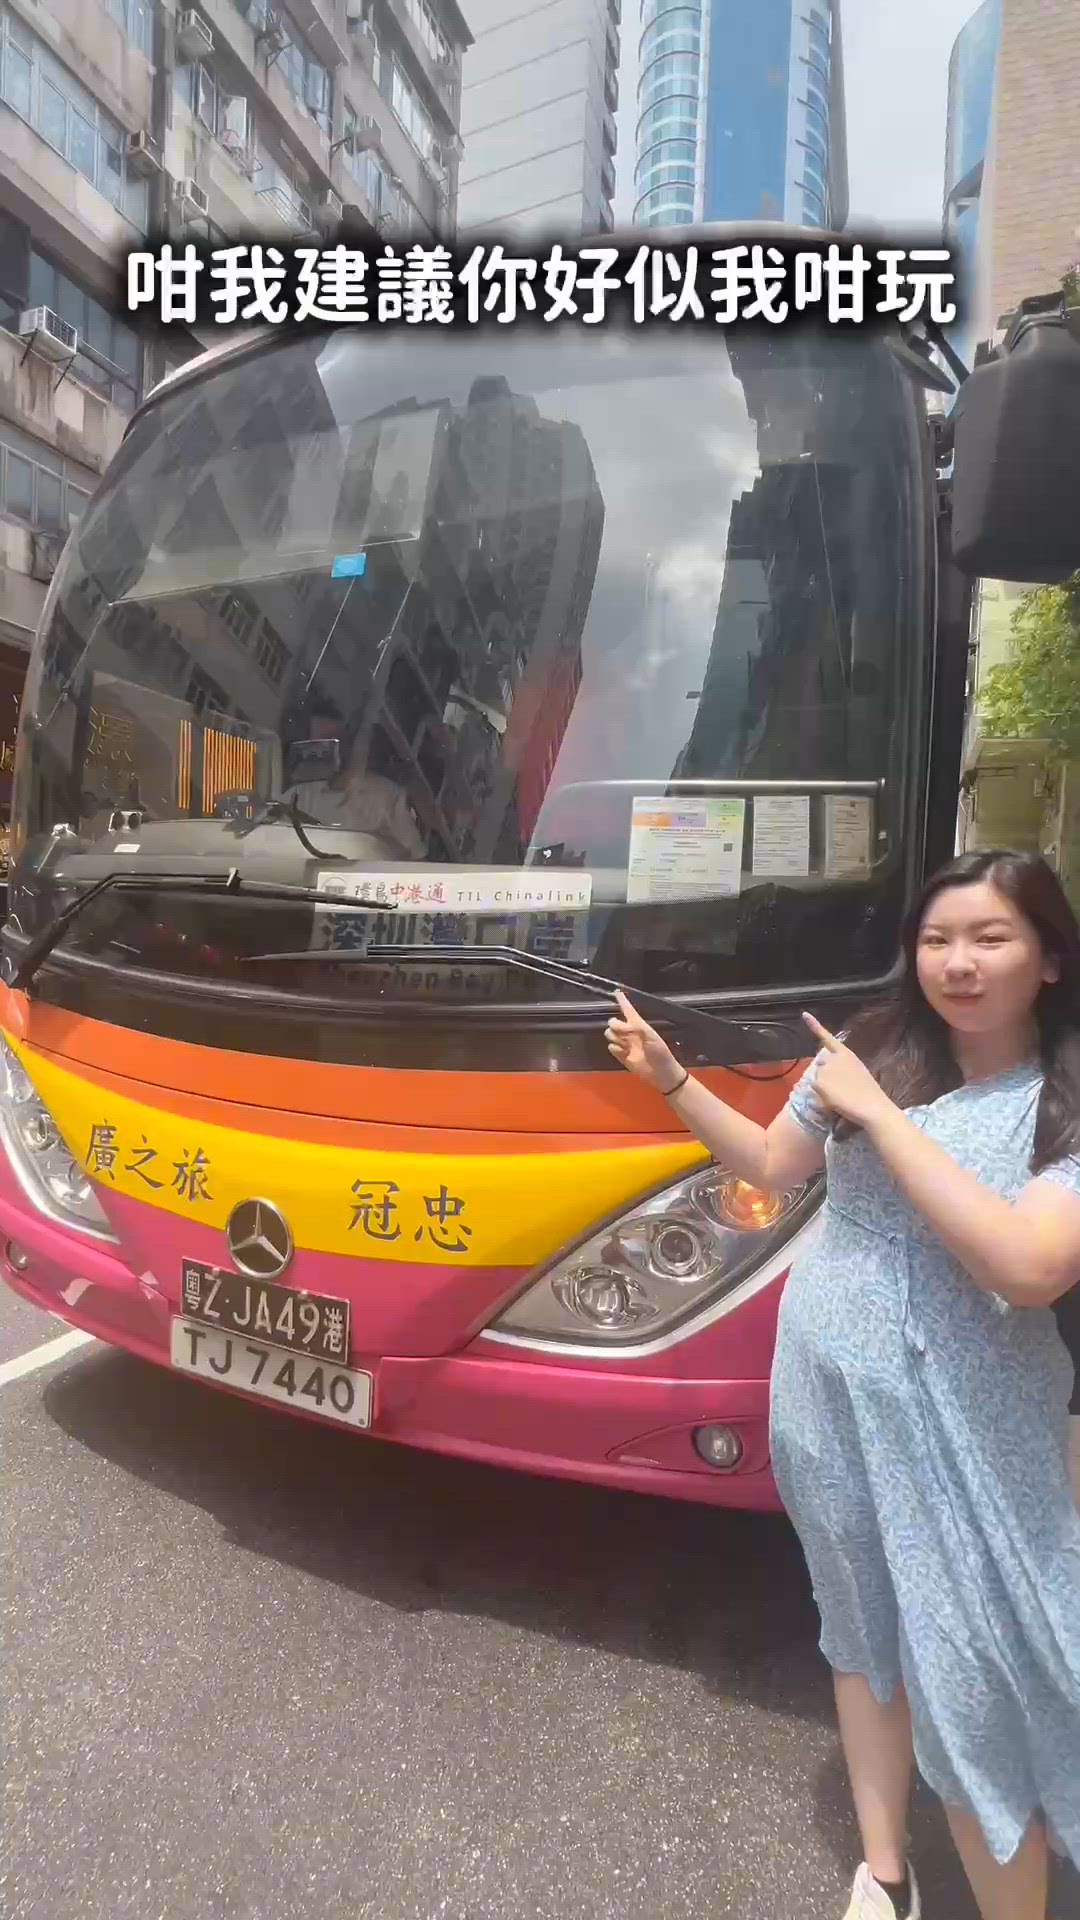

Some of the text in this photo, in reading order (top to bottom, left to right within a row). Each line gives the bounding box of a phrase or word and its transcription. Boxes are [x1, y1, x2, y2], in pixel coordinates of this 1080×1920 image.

[493, 890, 585, 901] Chinalink
[86, 1120, 214, 1201] 廣之旅
[347, 1178, 473, 1252] 冠忠
